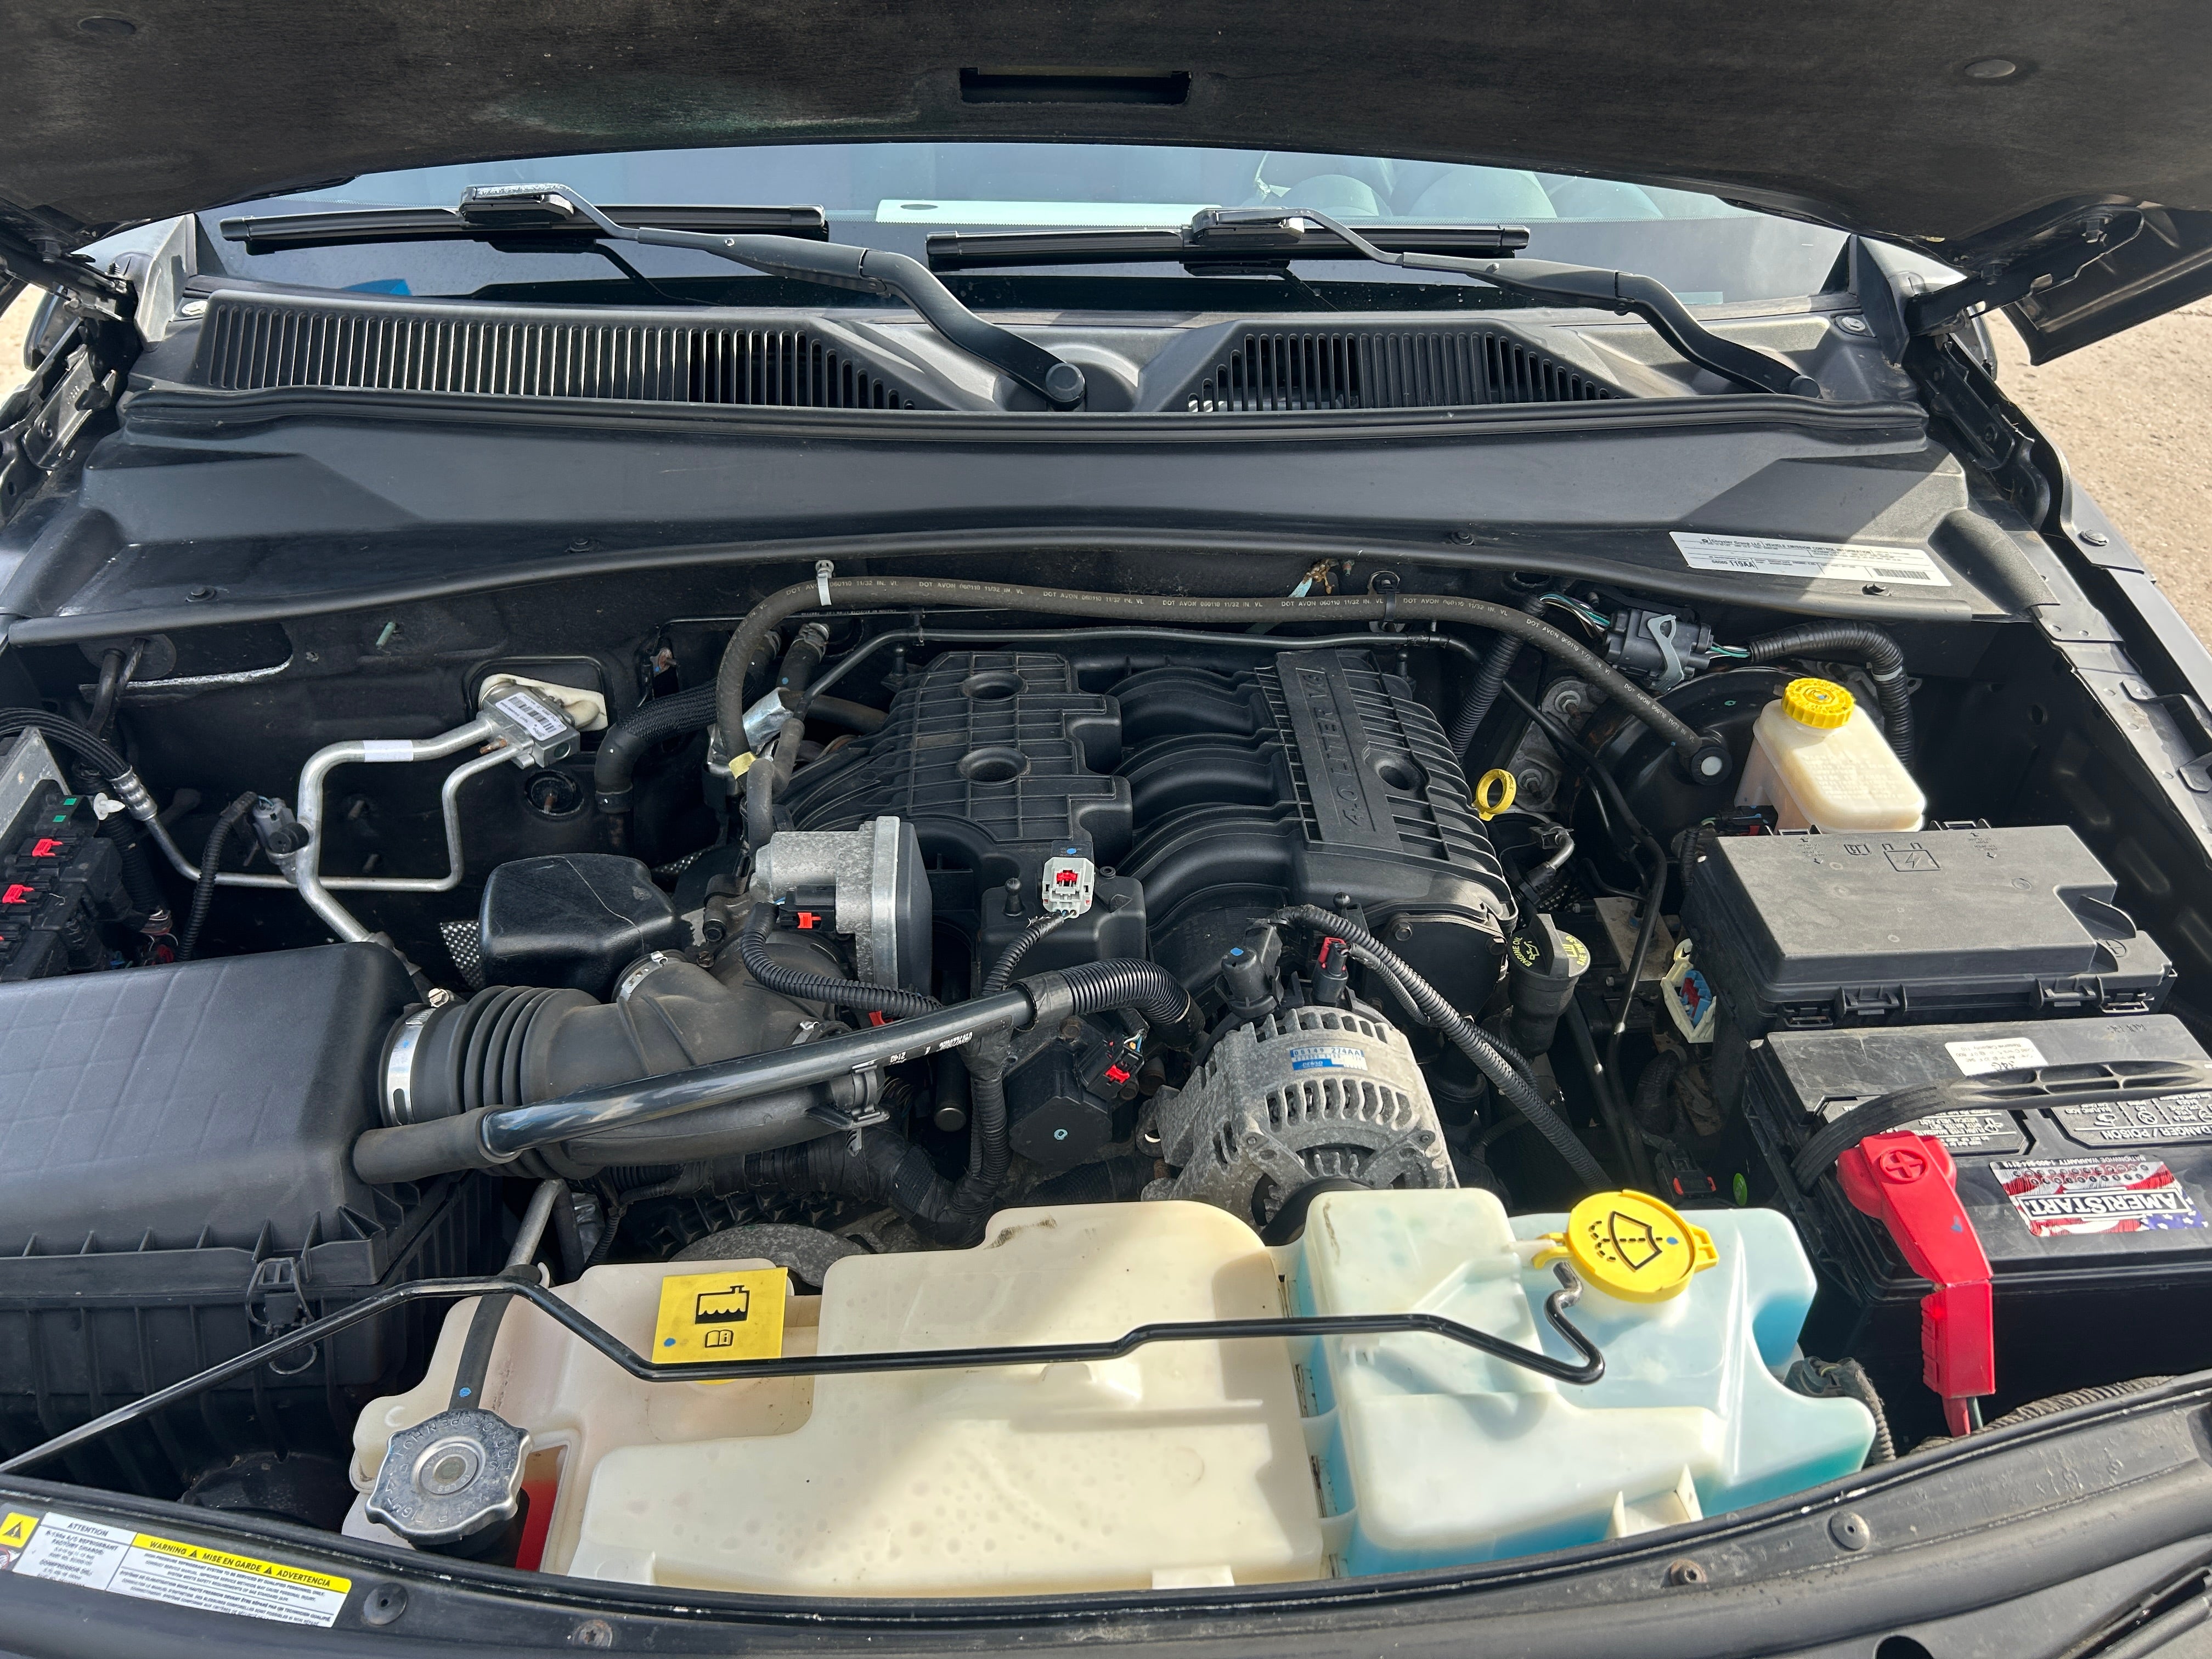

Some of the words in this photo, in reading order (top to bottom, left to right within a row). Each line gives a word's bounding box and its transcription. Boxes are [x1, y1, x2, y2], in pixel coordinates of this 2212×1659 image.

[786, 587, 801, 596] DOT
[1526, 618, 1541, 628] DOT
[1542, 626, 1560, 639] AVON
[1624, 683, 1635, 693] DOT
[1637, 692, 1651, 706] AVON
[1313, 707, 1352, 777] LITER
[1513, 936, 1523, 945] OIL
[1512, 945, 1533, 967] ENGINE
[1576, 954, 1588, 966] SAE
[2101, 1128, 2151, 1140] POISON
[2159, 1125, 2212, 1137] DANGER
[2059, 1156, 2098, 1166] WARRANTY
[2098, 1153, 2147, 1164] NATIONWIDE
[427, 1413, 472, 1434] OPEN
[473, 1414, 503, 1439] NOT
[496, 1439, 510, 1458] DO
[67, 1522, 109, 1537] ATTENTION
[149, 1540, 188, 1555] WARNING
[201, 1552, 223, 1564] MISE
[222, 1556, 234, 1566] EN
[235, 1560, 263, 1572] GARDE
[275, 1568, 331, 1587] ADVERTENCIA
